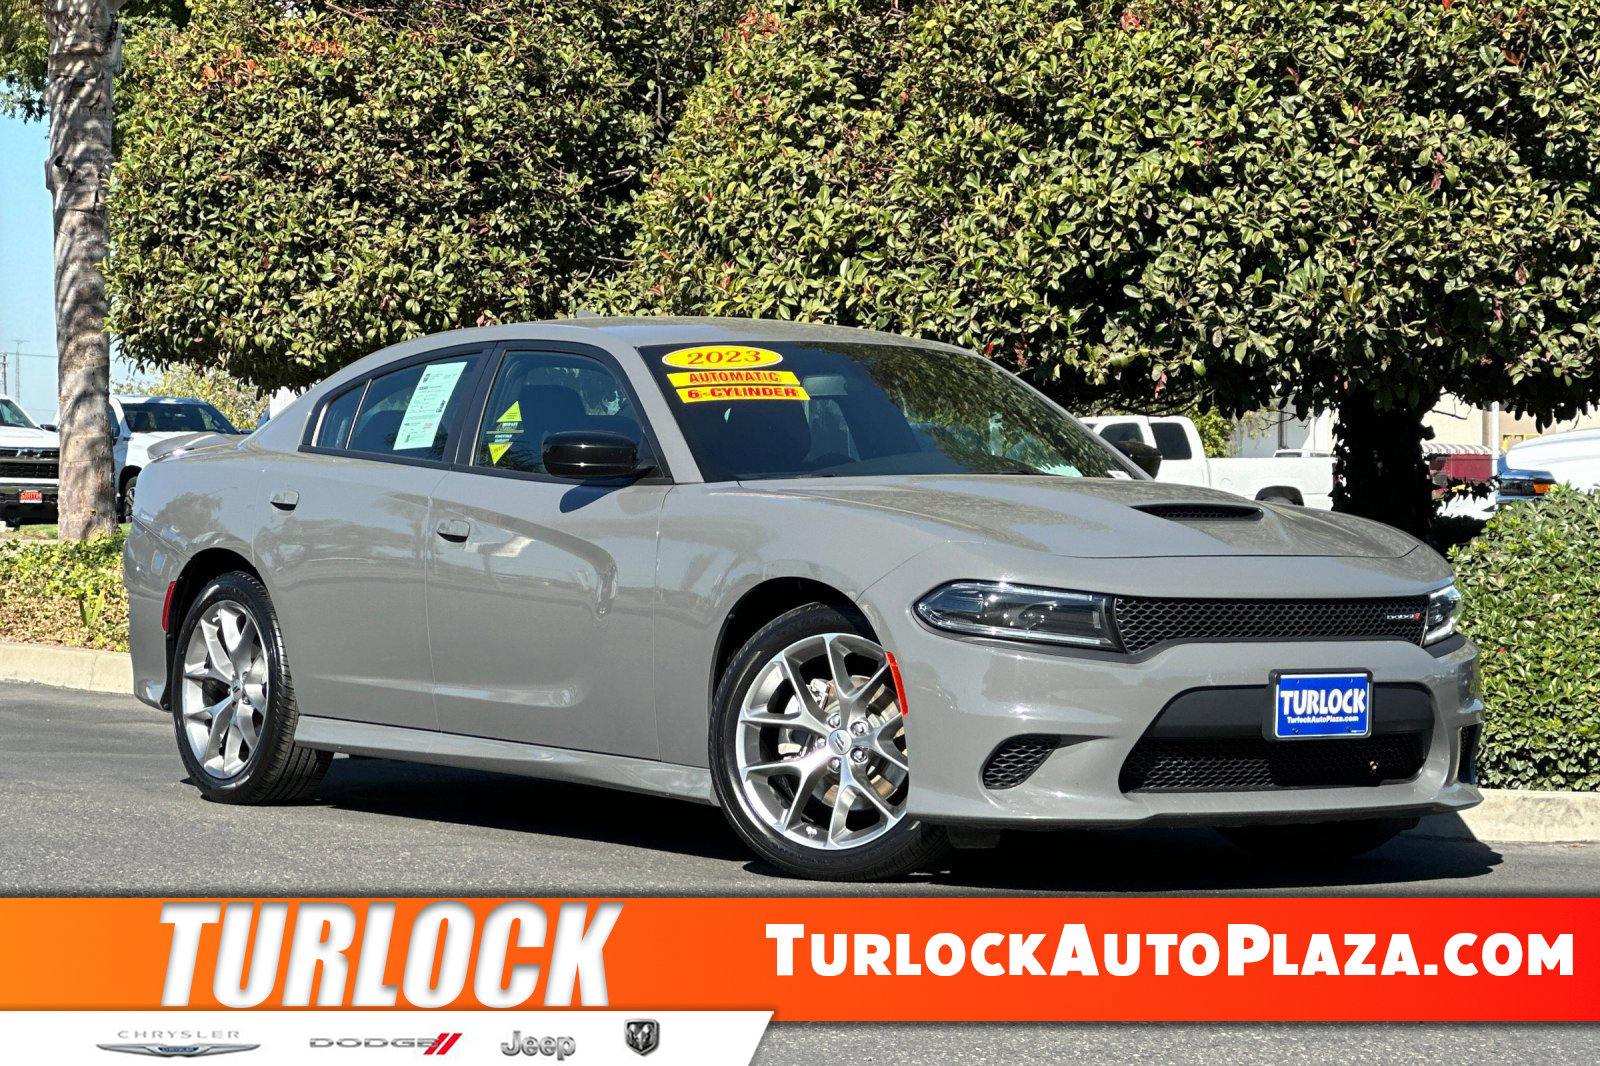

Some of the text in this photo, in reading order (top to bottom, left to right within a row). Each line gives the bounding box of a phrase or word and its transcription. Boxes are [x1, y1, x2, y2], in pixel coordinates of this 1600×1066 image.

[687, 350, 761, 365] 2023
[689, 371, 779, 383] AUTOMATIC
[687, 387, 797, 399] 6-CYLINDER
[1280, 688, 1366, 716] TURLOCK
[1287, 716, 1359, 724] TurlockAutoPlaza.com
